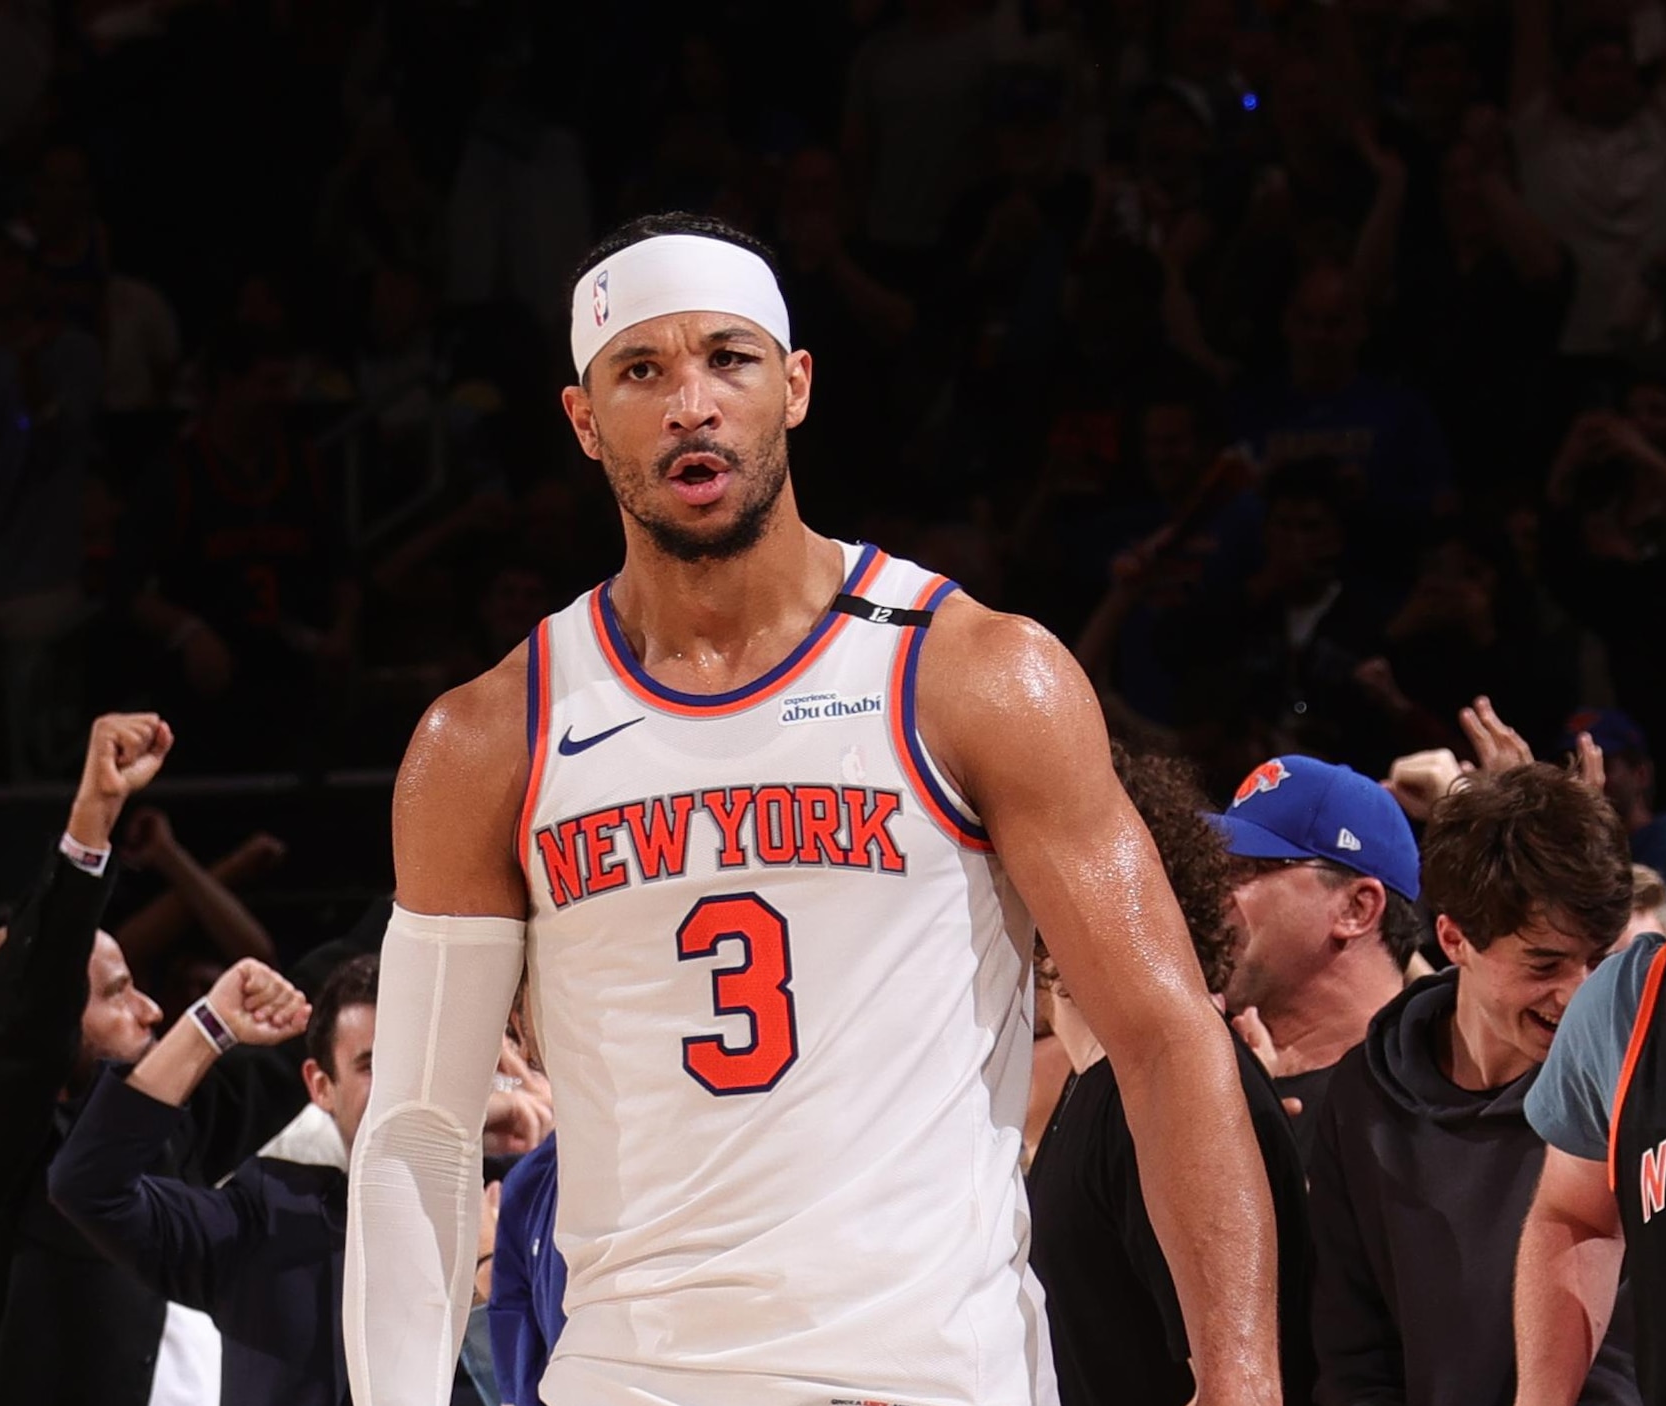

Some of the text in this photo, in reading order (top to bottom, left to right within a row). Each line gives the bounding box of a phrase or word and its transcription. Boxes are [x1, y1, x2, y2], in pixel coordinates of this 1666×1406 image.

[869, 607, 892, 622] 12
[782, 695, 882, 723] abu dhabi
[784, 692, 837, 706] experience
[536, 782, 908, 910] NEW YORK
[675, 890, 799, 1097] 3
